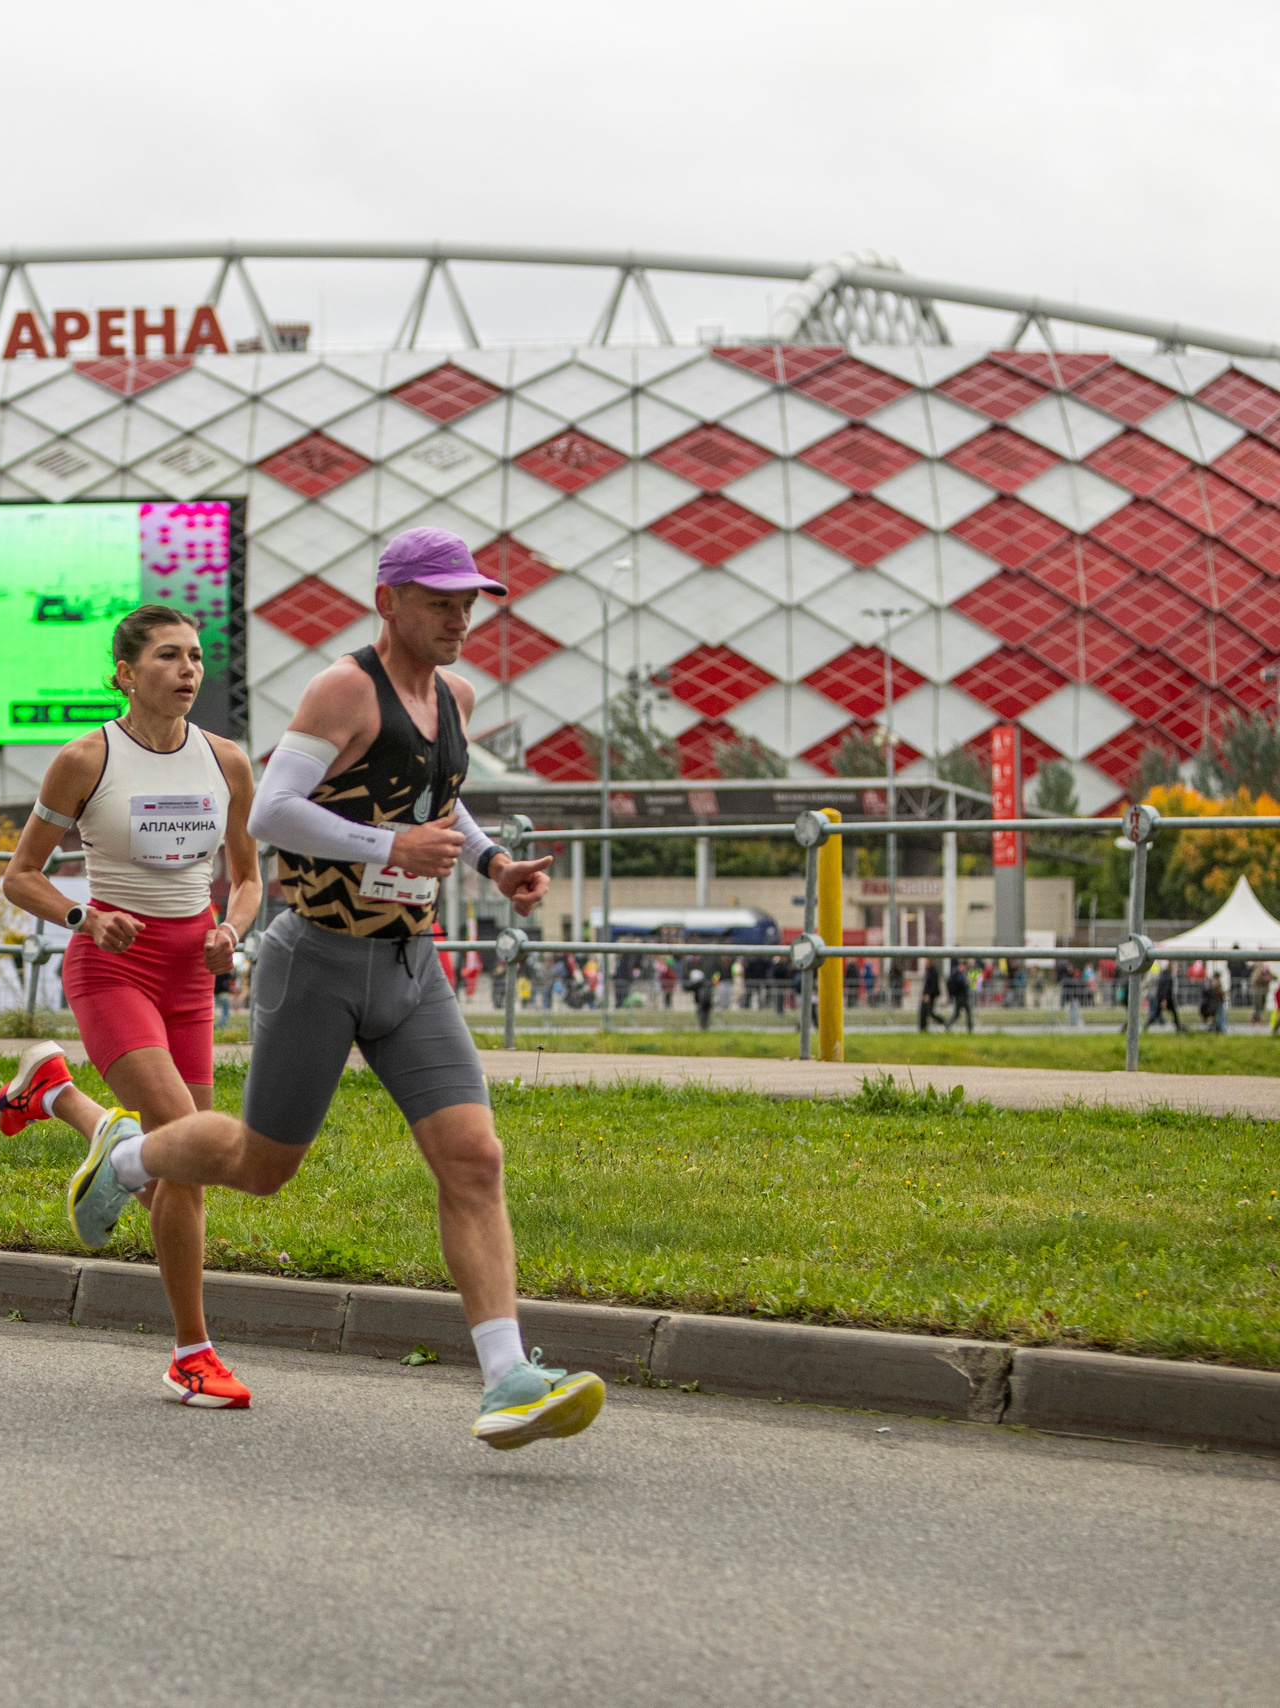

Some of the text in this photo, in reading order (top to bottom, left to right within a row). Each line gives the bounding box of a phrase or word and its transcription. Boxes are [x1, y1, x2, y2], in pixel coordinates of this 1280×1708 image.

[3, 305, 230, 359] АРЕНА
[139, 821, 216, 832] АПЛАЧКИНА
[175, 837, 185, 845] 17
